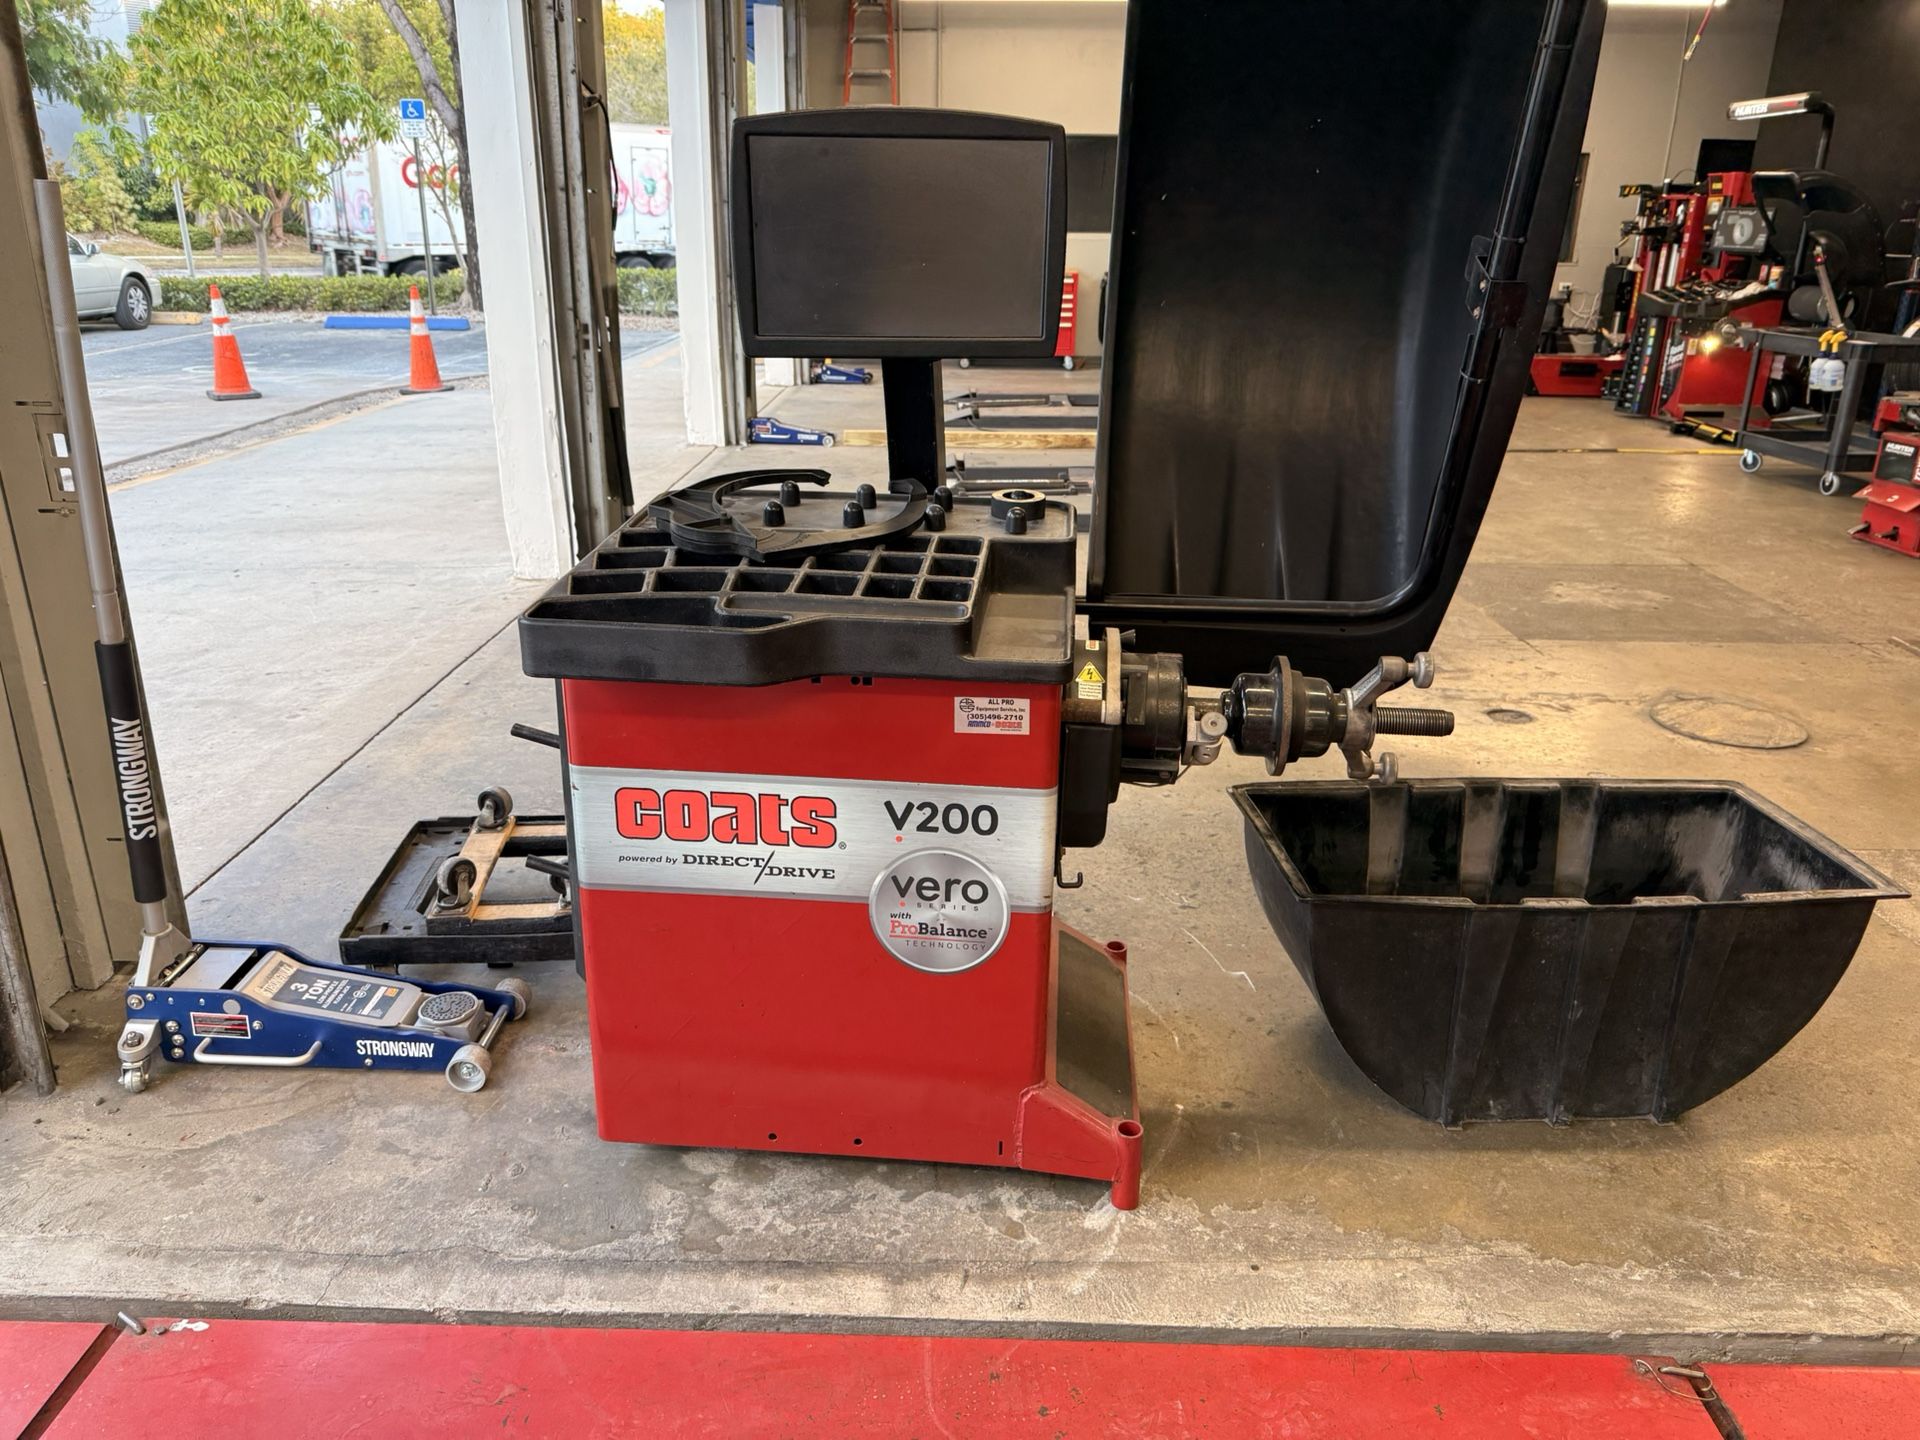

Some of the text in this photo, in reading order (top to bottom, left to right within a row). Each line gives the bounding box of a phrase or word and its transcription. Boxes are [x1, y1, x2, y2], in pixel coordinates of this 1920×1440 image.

[111, 717, 158, 842] STRONGWAY
[884, 800, 999, 837] V200
[619, 854, 664, 865] powered
[666, 855, 678, 866] by
[891, 875, 988, 905] vero
[917, 902, 979, 912] SERIES
[890, 912, 912, 920] with
[905, 940, 987, 951] TECHNOLOGY
[290, 982, 309, 993] 3
[302, 979, 332, 1001] TON
[356, 1039, 435, 1058] STRONGWAY
